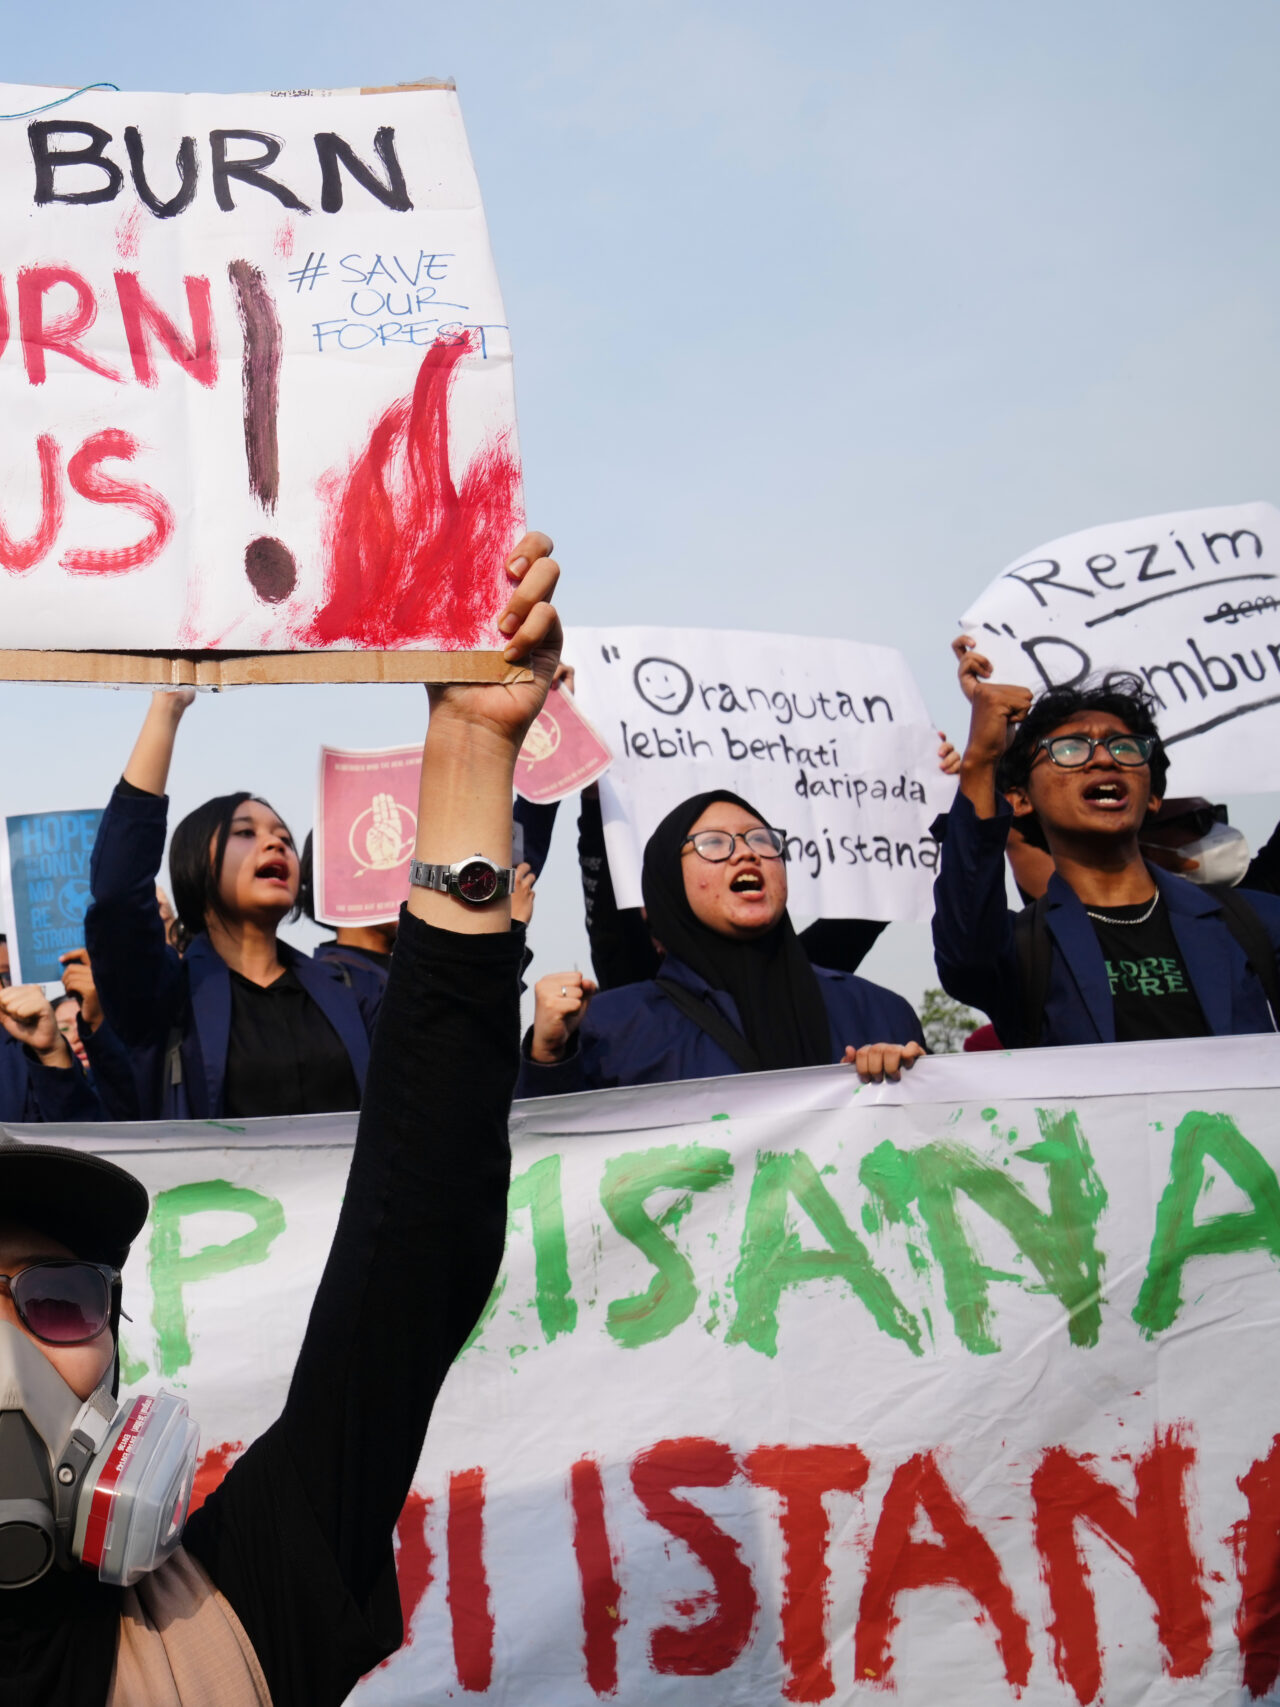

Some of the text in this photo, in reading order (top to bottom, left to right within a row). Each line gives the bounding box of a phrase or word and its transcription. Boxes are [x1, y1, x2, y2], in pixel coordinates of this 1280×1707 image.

[27, 118, 415, 219] BURN
[350, 286, 470, 316] OUR
[312, 318, 510, 360] FOREST
[1002, 529, 1263, 607] Rezim
[620, 720, 838, 768] lebih berhati
[794, 768, 927, 808] daripada
[21, 814, 96, 856] HOPE
[40, 852, 87, 878] ONLY
